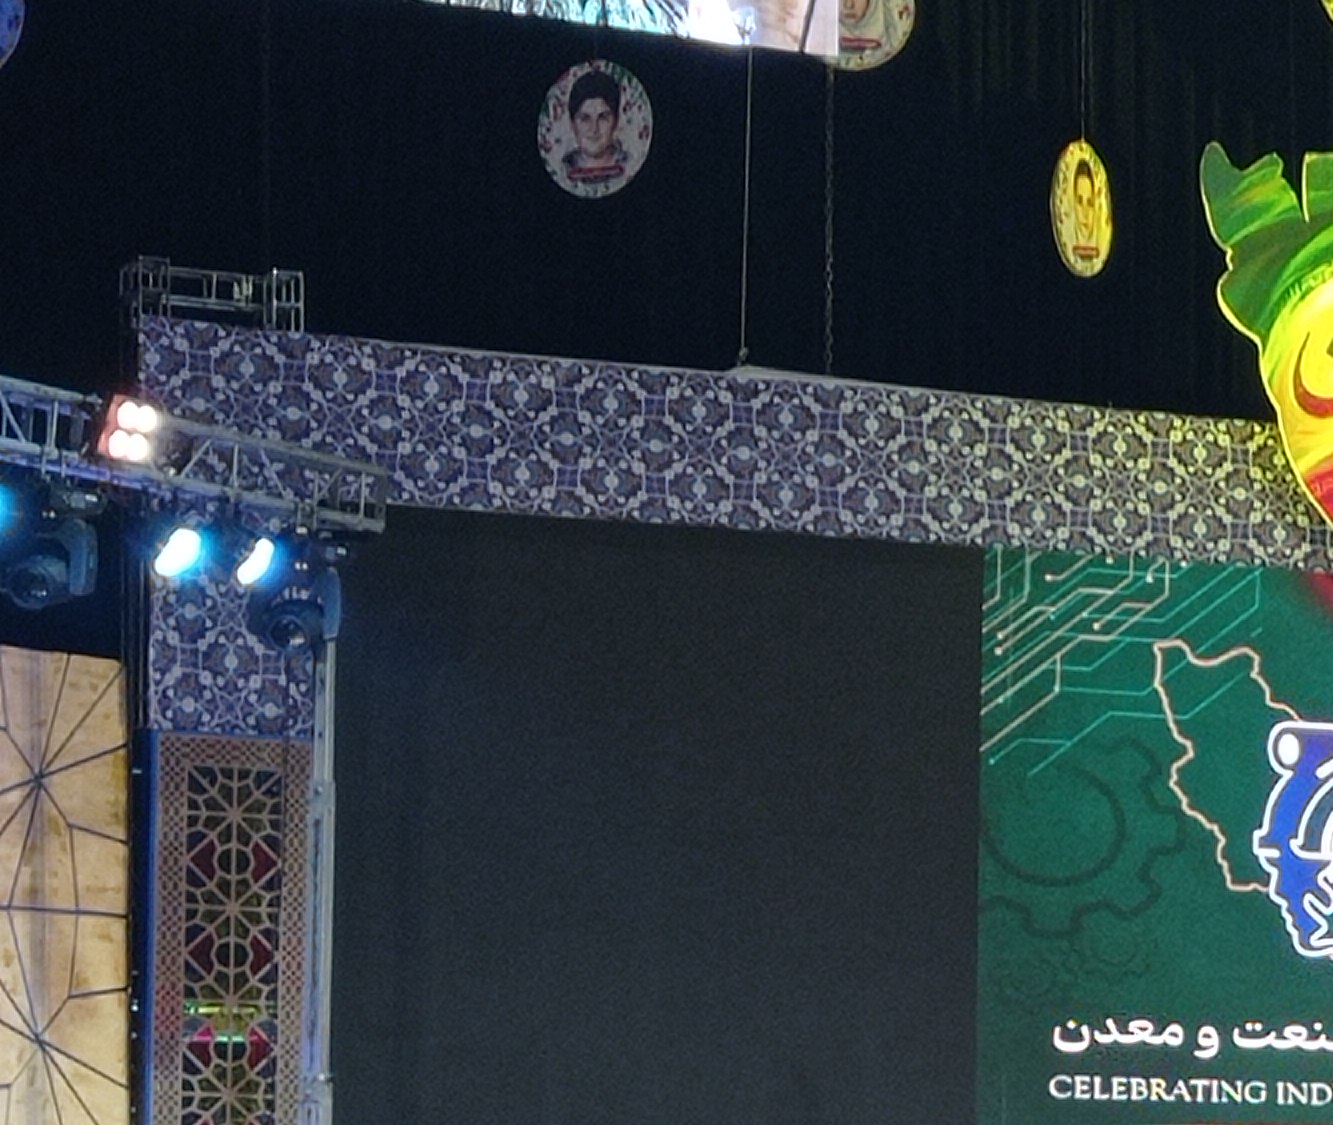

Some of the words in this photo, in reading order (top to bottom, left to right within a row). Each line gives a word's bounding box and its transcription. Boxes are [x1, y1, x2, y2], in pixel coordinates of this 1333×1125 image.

[1052, 1017, 1185, 1053] معدن
[1193, 1023, 1220, 1059] و
[1048, 1074, 1268, 1104] CELEBRATING
